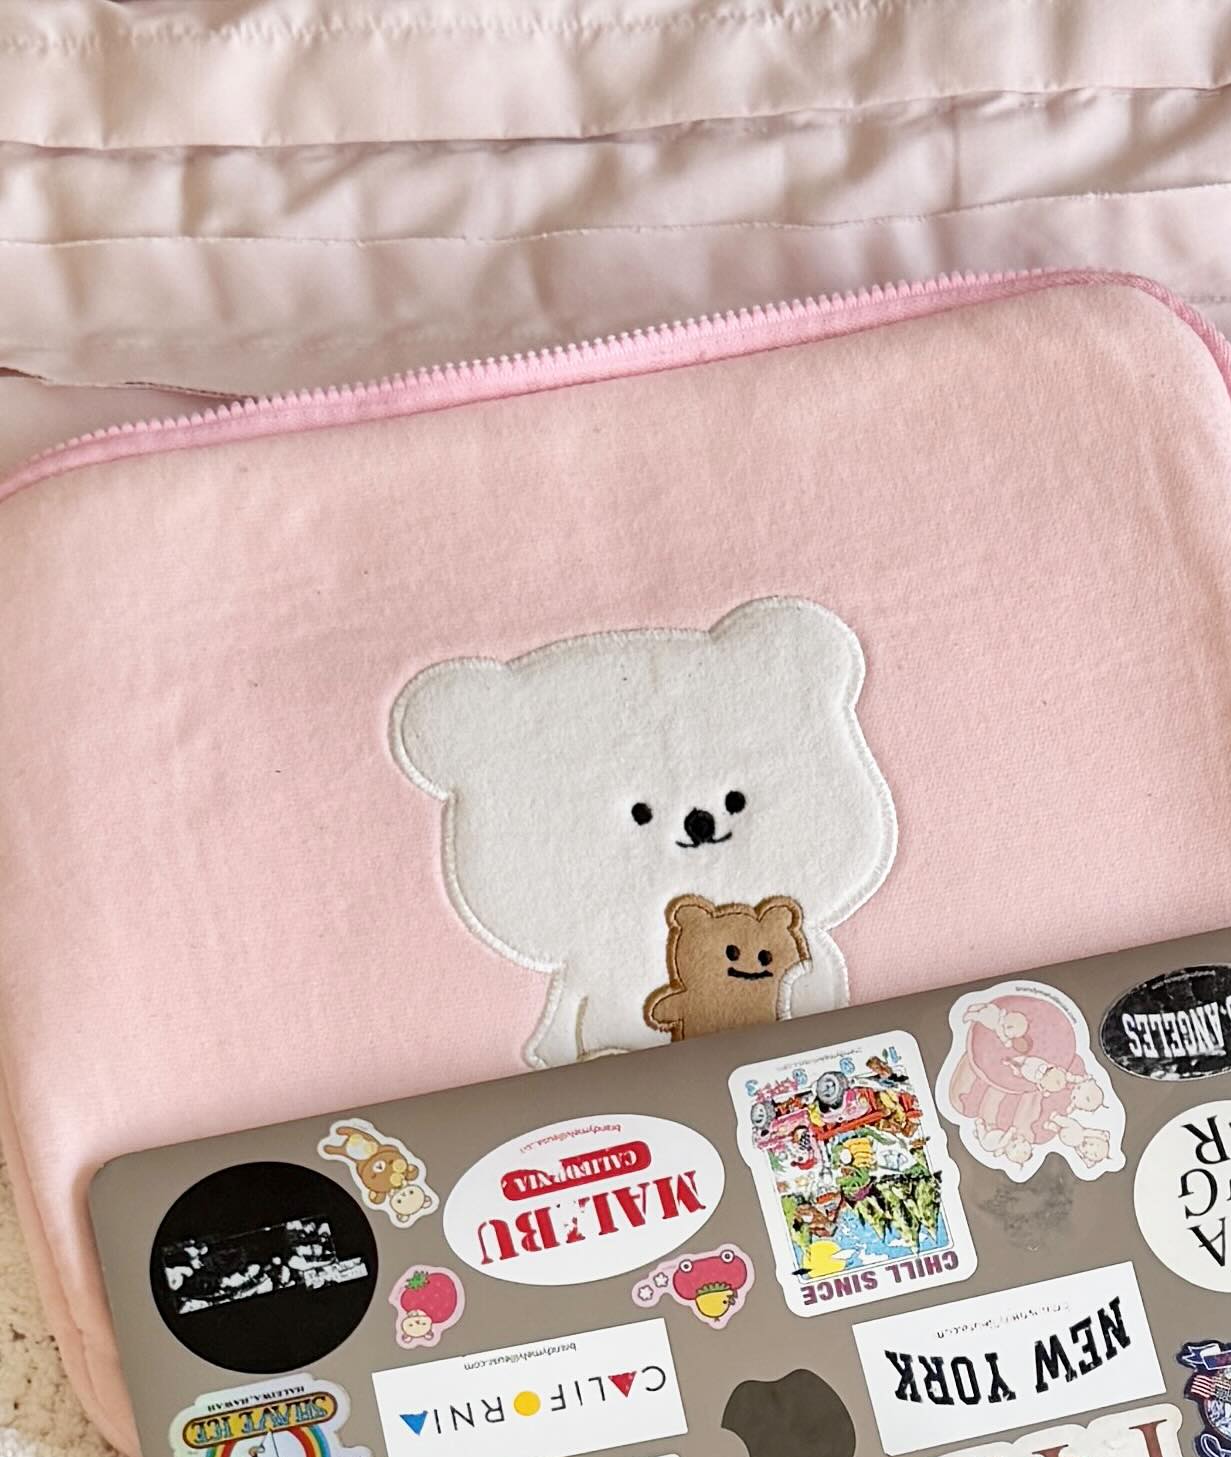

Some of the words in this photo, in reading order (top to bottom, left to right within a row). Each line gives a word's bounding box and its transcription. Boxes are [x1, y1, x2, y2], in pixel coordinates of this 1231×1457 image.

[801, 1269, 879, 1308] SINCE
[882, 1249, 960, 1291] CHILL
[1034, 1295, 1134, 1393] NEW
[884, 1347, 1018, 1407] YORK
